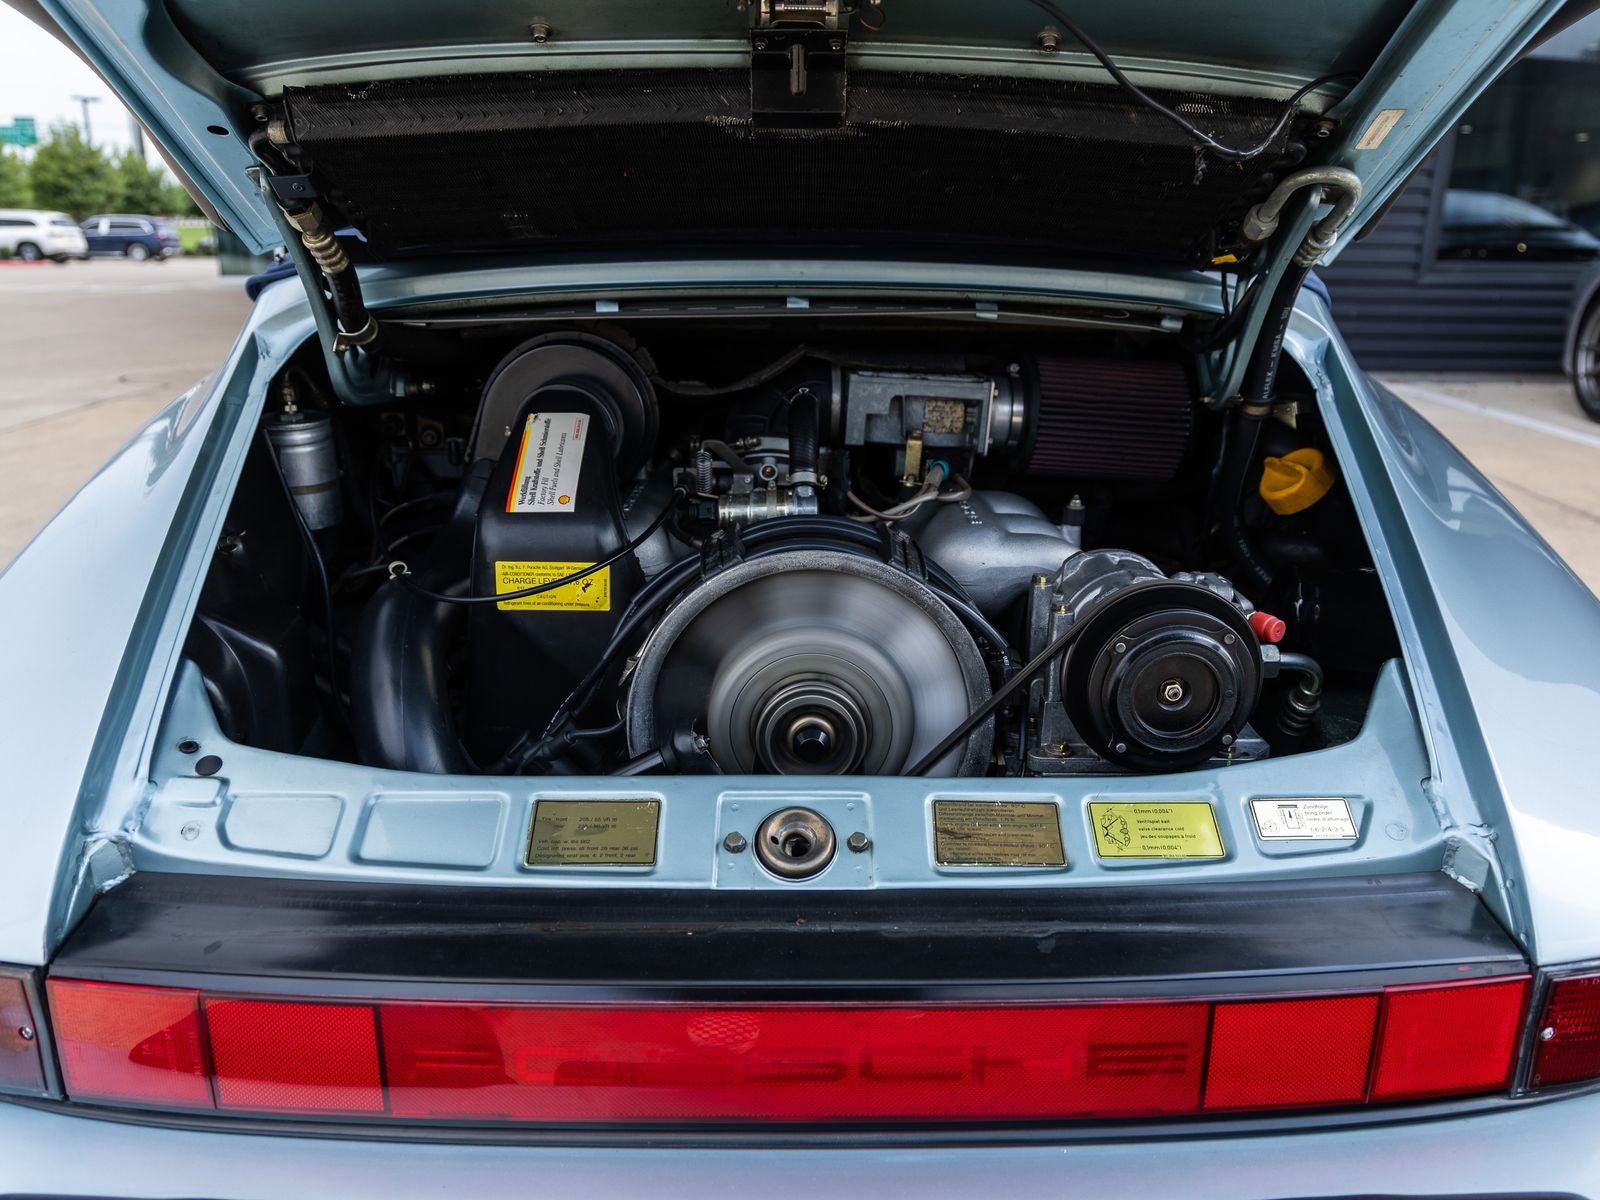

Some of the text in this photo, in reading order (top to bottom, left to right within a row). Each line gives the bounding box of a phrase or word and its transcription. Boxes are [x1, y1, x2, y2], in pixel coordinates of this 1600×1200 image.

[553, 456, 562, 469] Shell
[528, 492, 537, 506] Shell
[537, 447, 546, 458] Shell
[552, 467, 560, 478] and
[547, 492, 555, 506] Shell
[502, 577, 536, 585] CHARGE
